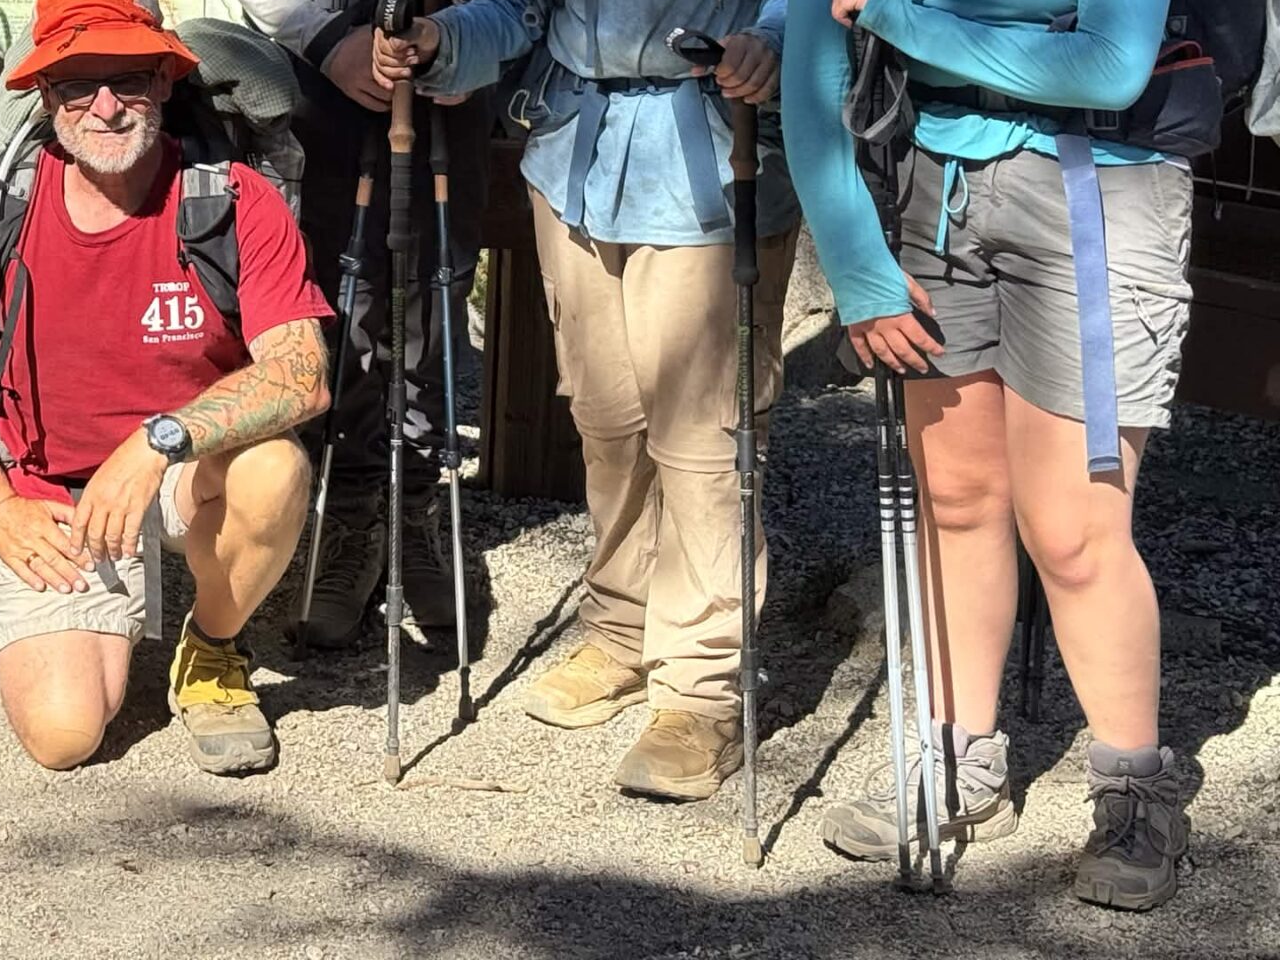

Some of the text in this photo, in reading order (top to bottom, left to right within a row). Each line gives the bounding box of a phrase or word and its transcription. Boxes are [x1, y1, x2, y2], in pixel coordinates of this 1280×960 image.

[141, 294, 205, 332] 415
[142, 332, 204, 343] San Francisco
